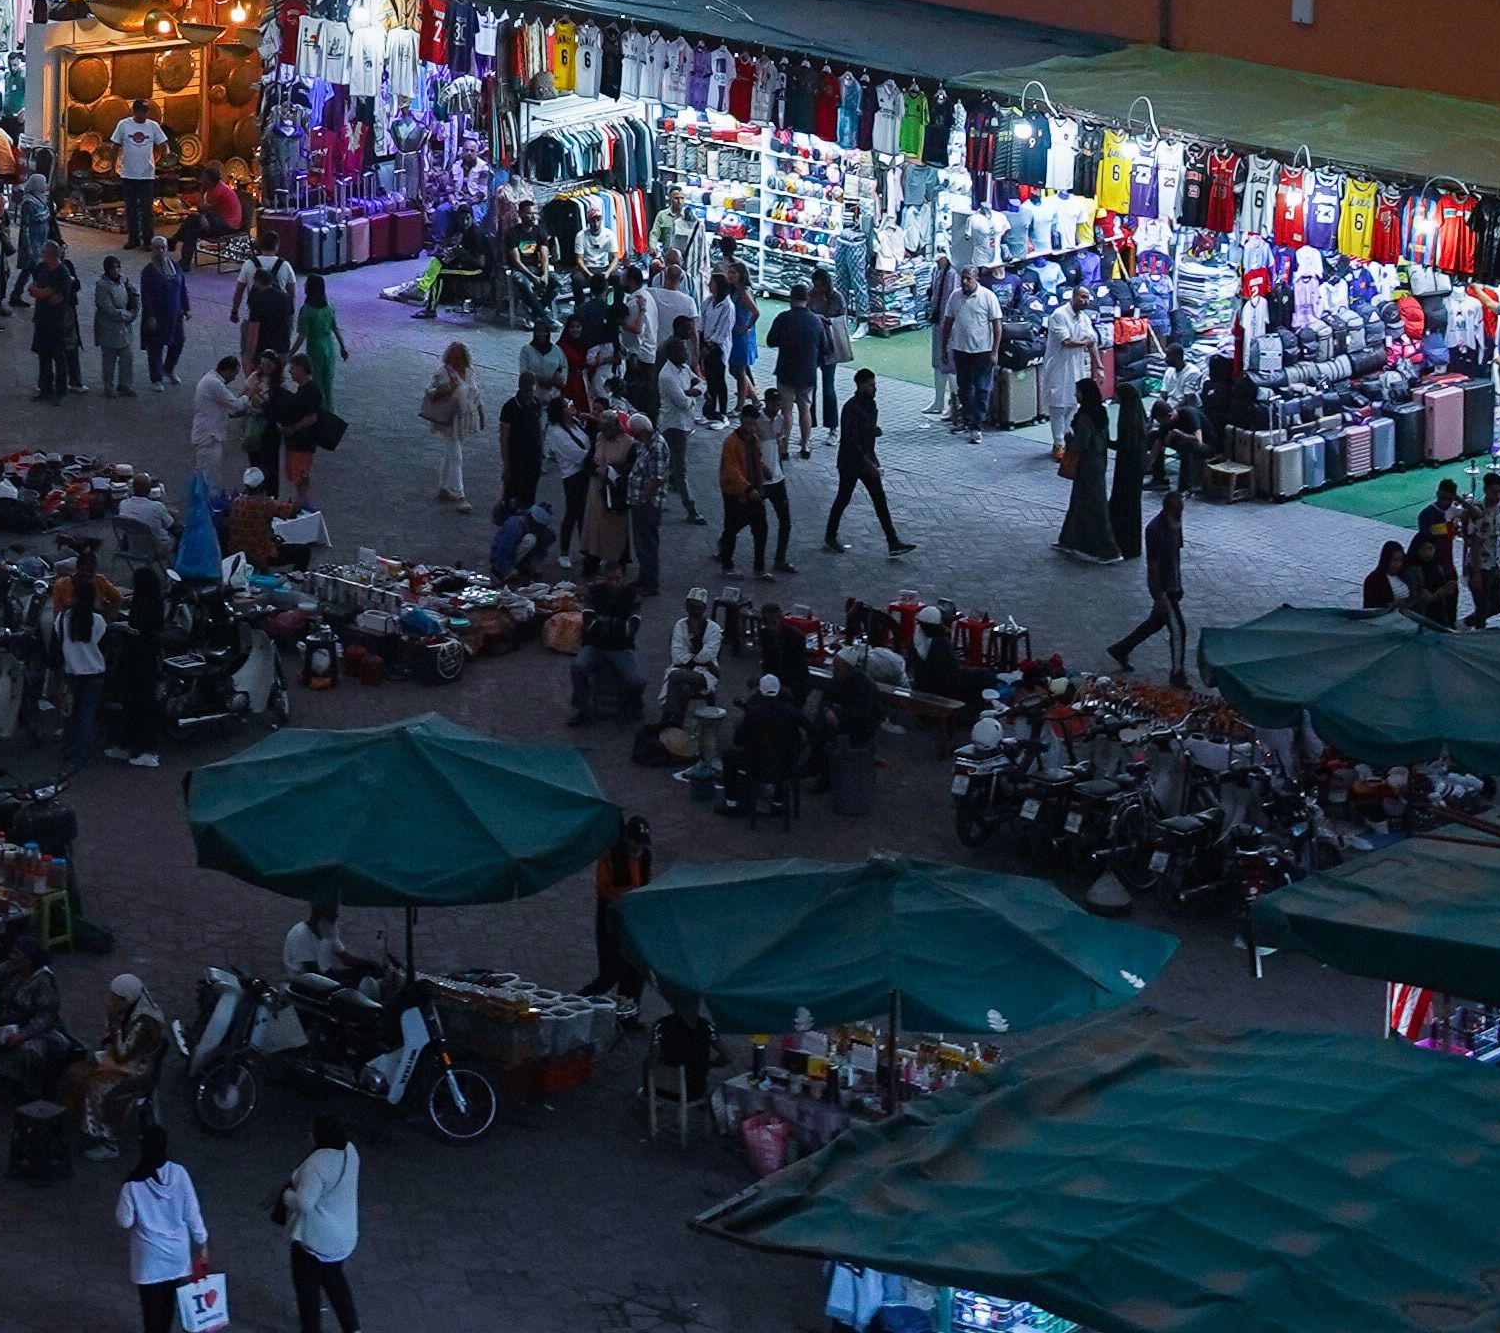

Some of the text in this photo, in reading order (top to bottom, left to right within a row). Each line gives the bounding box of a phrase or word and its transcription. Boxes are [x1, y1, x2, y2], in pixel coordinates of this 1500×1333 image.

[432, 21, 442, 43] 2
[561, 49, 568, 65] 6
[584, 51, 591, 68] 6
[1028, 137, 1036, 148] 9
[1112, 164, 1121, 182] 6
[1254, 189, 1265, 208] 6
[1354, 212, 1365, 232] 6
[192, 1293, 207, 1314] I
